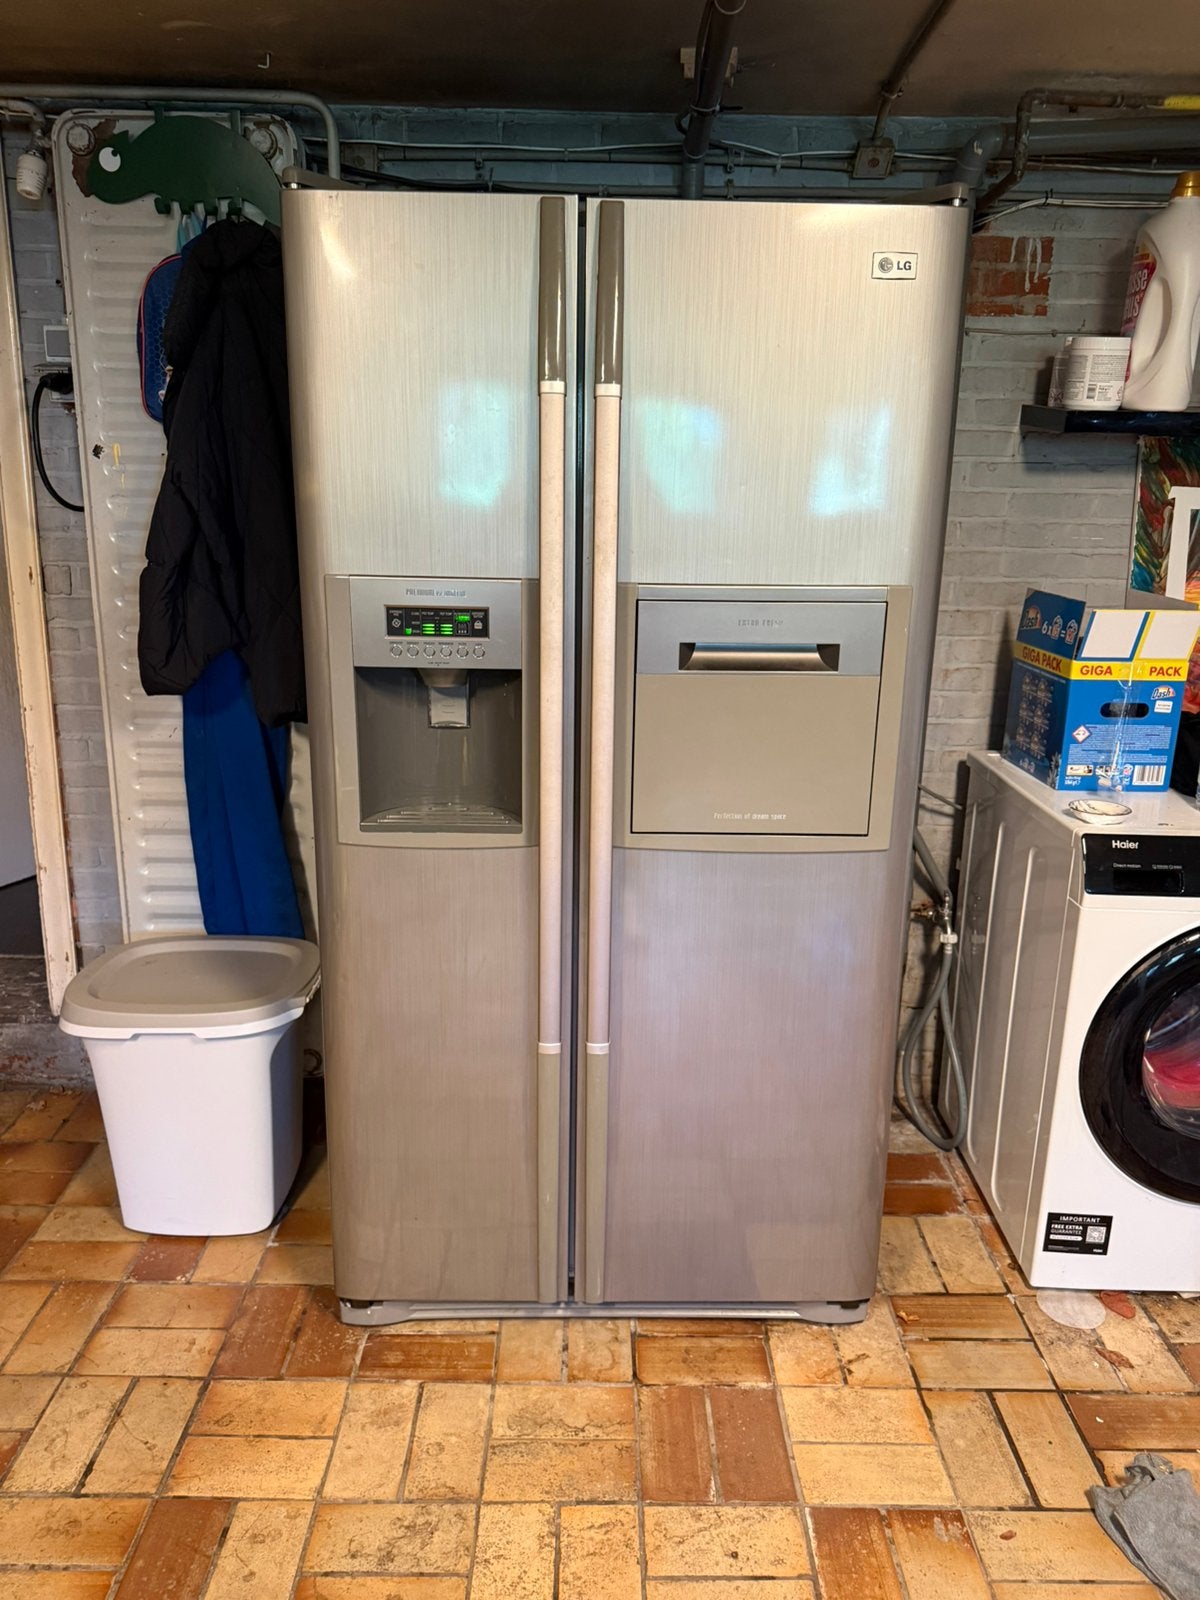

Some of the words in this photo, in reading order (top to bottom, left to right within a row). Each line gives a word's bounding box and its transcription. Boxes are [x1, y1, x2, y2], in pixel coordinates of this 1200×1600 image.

[896, 260, 912, 271] LG
[1022, 645, 1041, 665] GIGA
[1041, 652, 1063, 674] PACK
[1080, 665, 1113, 676] GIGA
[1149, 666, 1182, 677] PACK
[1151, 687, 1172, 700] Dash
[1112, 840, 1139, 849] Haier
